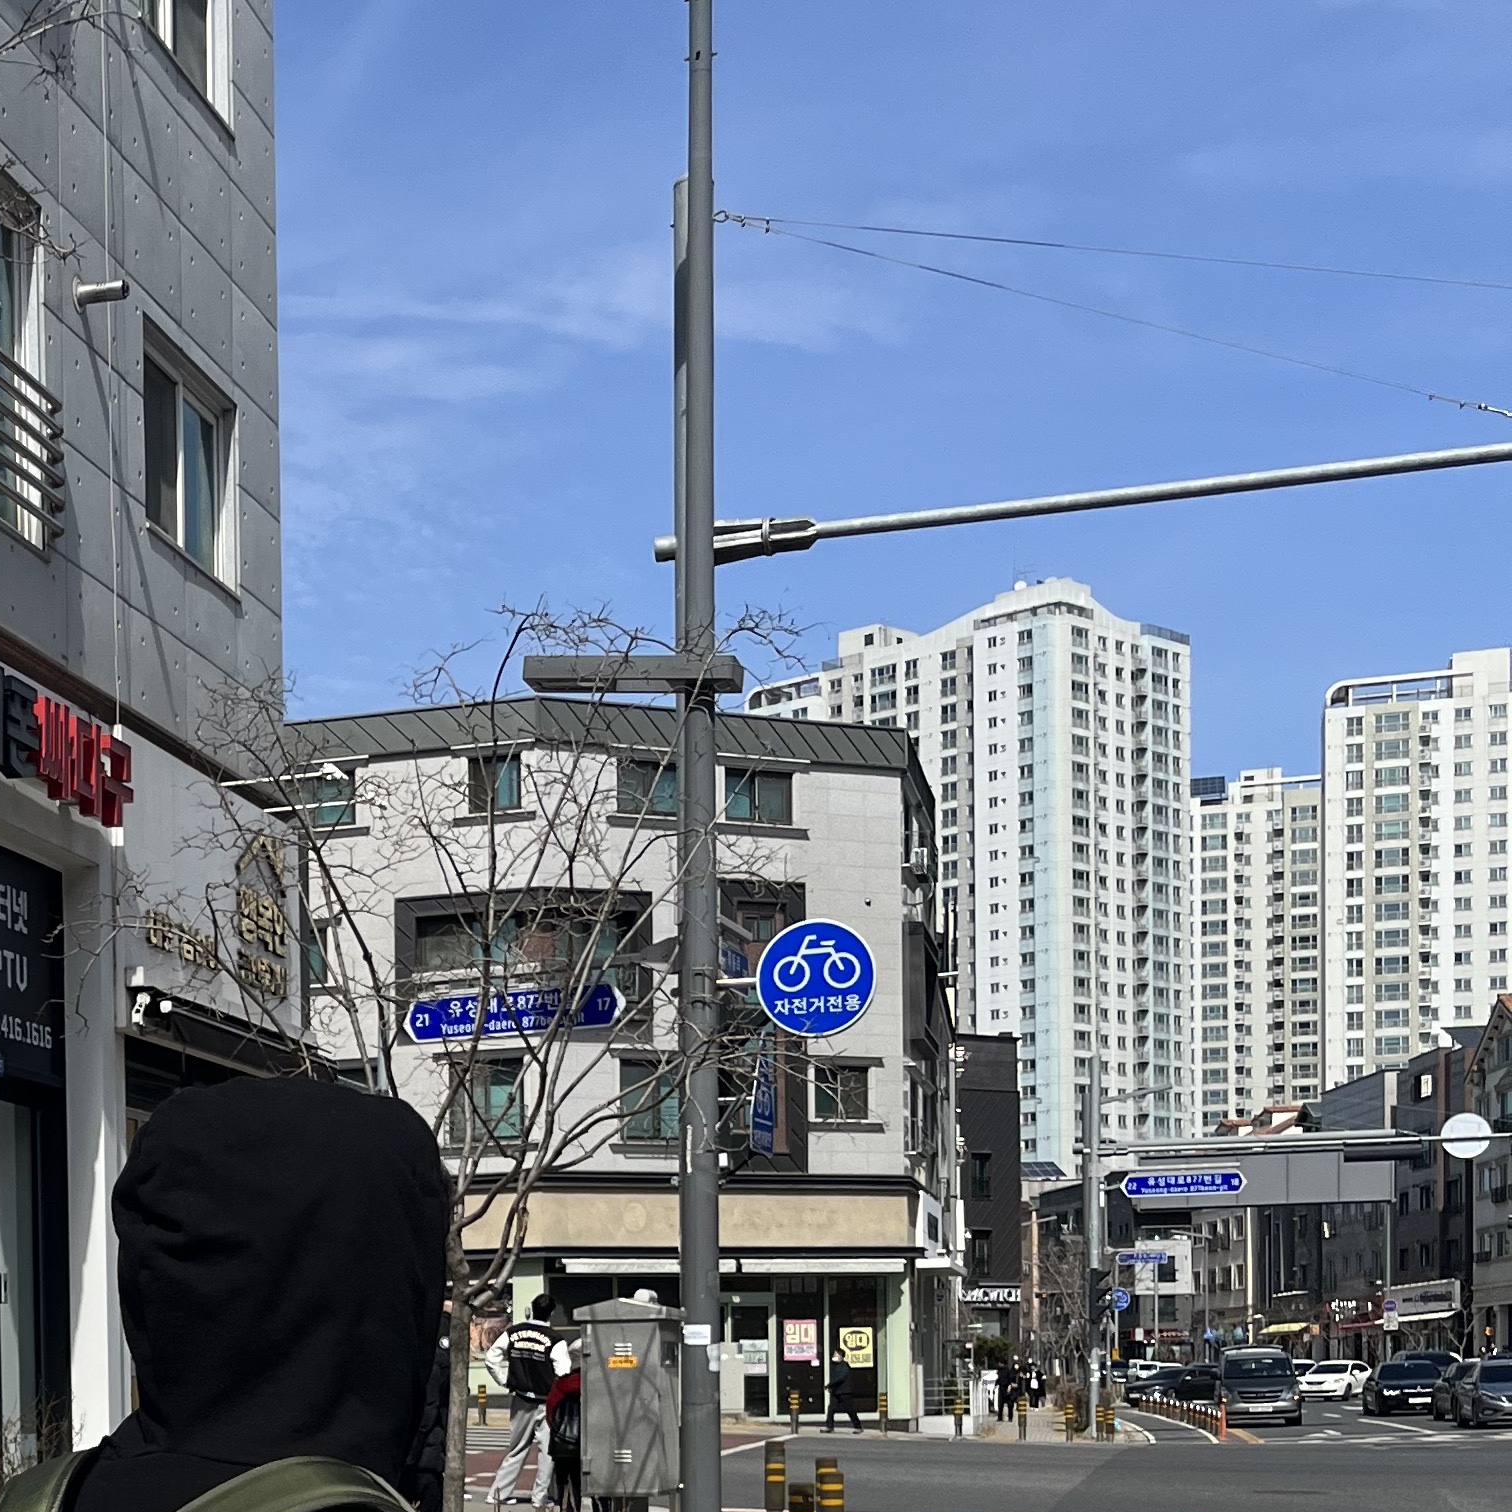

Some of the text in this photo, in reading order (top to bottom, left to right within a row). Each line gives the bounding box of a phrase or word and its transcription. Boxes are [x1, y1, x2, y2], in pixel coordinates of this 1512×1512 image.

[596, 998, 611, 1011] 17
[773, 993, 863, 1017] 자전거전용
[415, 1013, 430, 1028] 21
